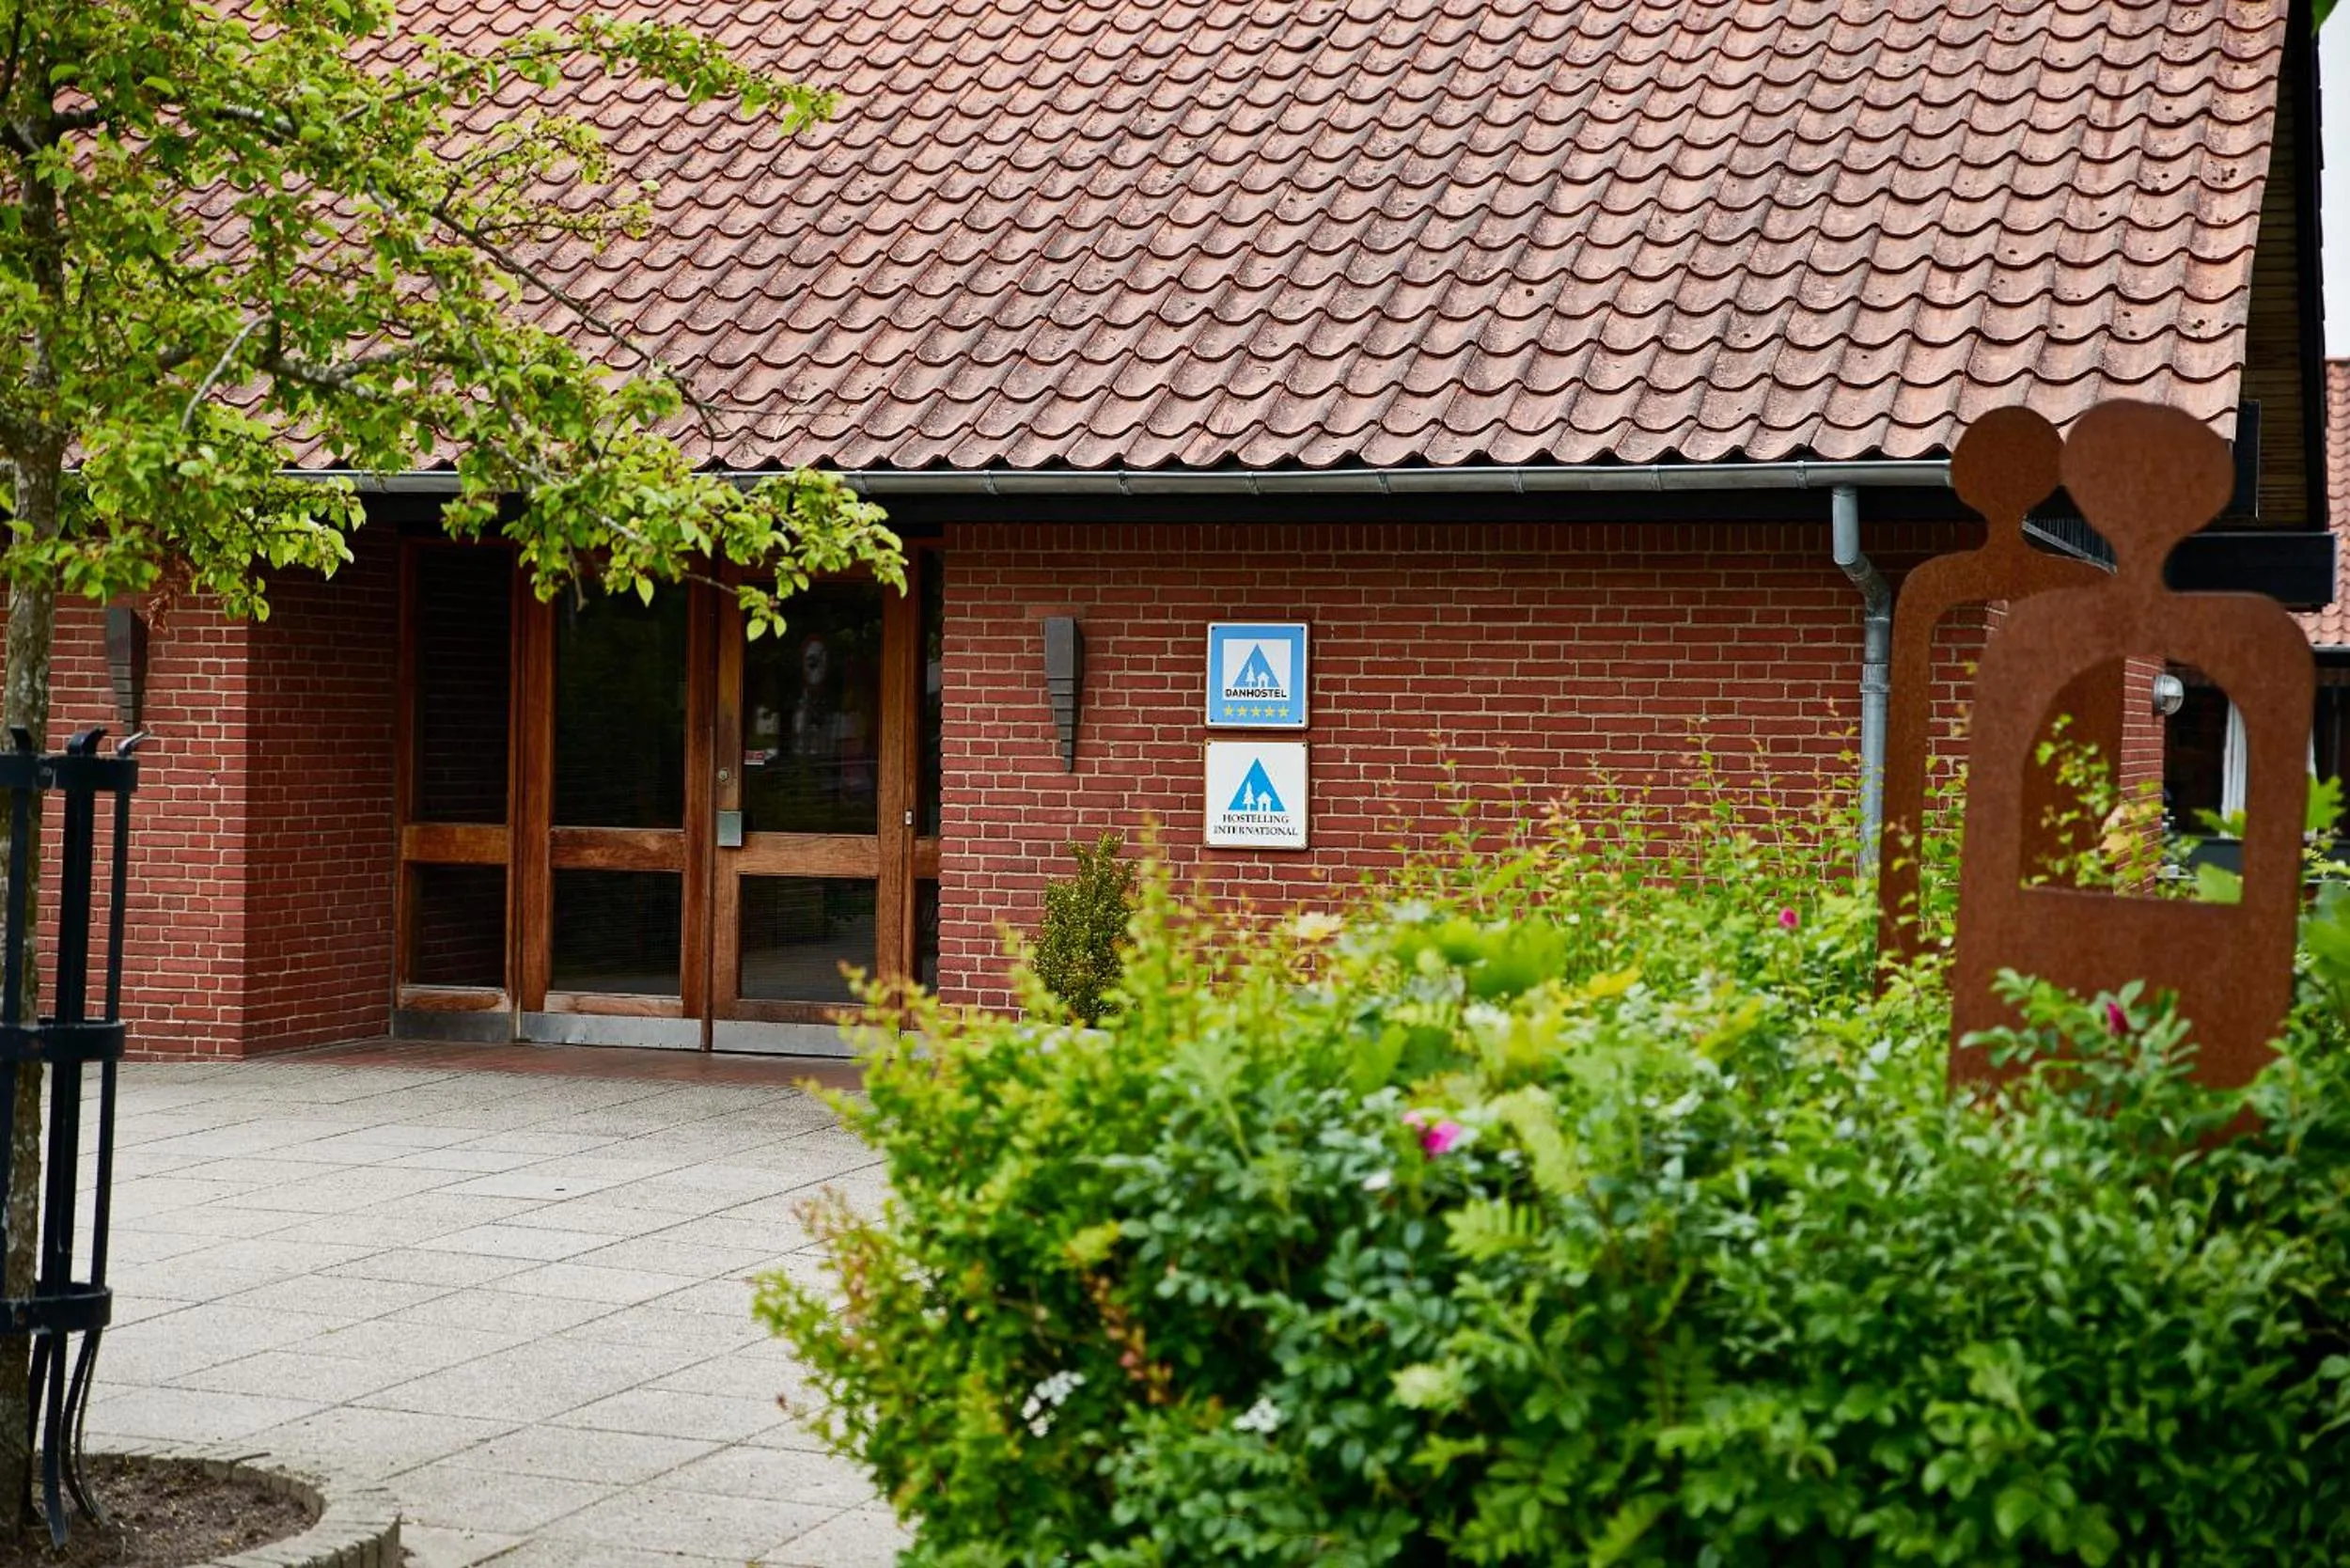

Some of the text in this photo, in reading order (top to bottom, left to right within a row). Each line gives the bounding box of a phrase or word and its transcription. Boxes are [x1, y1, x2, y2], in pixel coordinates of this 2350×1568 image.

[1225, 688, 1287, 698] DANHOSTEL
[1223, 814, 1289, 823] HOSTELLING
[1214, 825, 1298, 836] INTERNATIONAL
